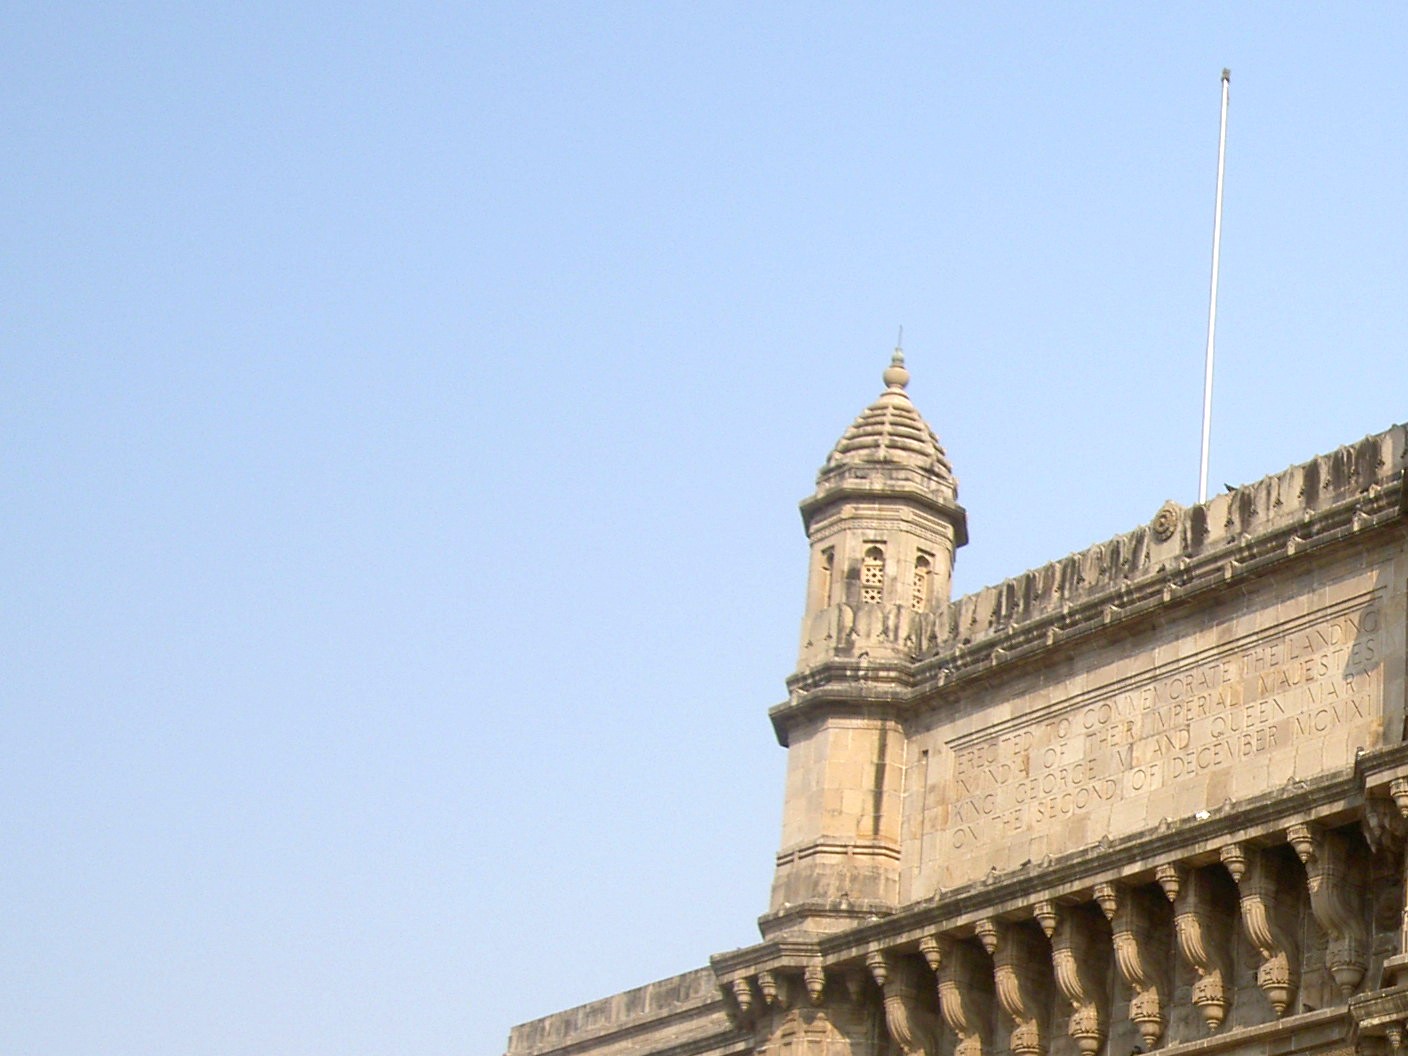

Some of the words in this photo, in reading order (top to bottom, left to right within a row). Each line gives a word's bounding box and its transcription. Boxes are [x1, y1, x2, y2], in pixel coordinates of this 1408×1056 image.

[953, 793, 995, 824] KING
[1016, 758, 1097, 803] GEORGE
[1117, 746, 1132, 767] V
[1153, 728, 1191, 757] AND
[1211, 698, 1286, 739] QUEEN
[1306, 668, 1373, 704] MARY
[957, 732, 1034, 774] ERECTED
[1045, 718, 1070, 745] TO
[1083, 661, 1231, 729] COMMEMORATE
[1242, 644, 1279, 674] THE
[1289, 611, 1378, 660] LANDING
[1043, 742, 1068, 768] OF
[1152, 686, 1239, 731] IMPERIAL
[1259, 639, 1375, 697] MAJESTIES
[953, 823, 980, 848] ON
[991, 808, 1022, 837] THE
[1036, 779, 1117, 823] SECOND
[1132, 764, 1159, 791] OF
[1173, 725, 1278, 778] DECEMBER
[1295, 694, 1371, 735] MCMXI
